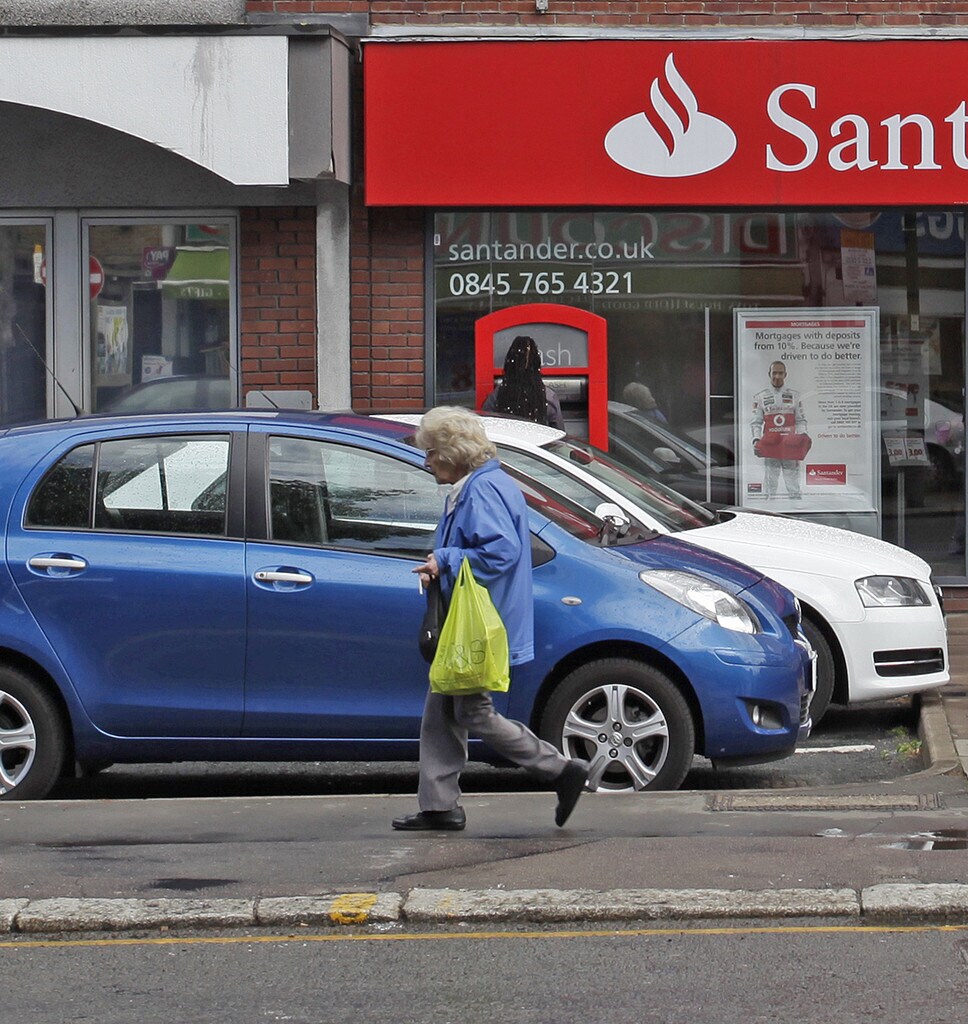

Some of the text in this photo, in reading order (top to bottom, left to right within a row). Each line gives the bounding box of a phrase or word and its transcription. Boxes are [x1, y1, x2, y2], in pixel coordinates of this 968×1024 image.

[448, 236, 655, 261] santander.co.uk
[449, 271, 632, 296] 0845 765 4321
[755, 332, 801, 341] Mortgages
[825, 331, 861, 341] deposits
[538, 342, 571, 366] ash
[754, 341, 861, 350] from 10%. Because we're
[781, 352, 807, 360] driven
[821, 352, 833, 360] do
[835, 352, 863, 360] better.
